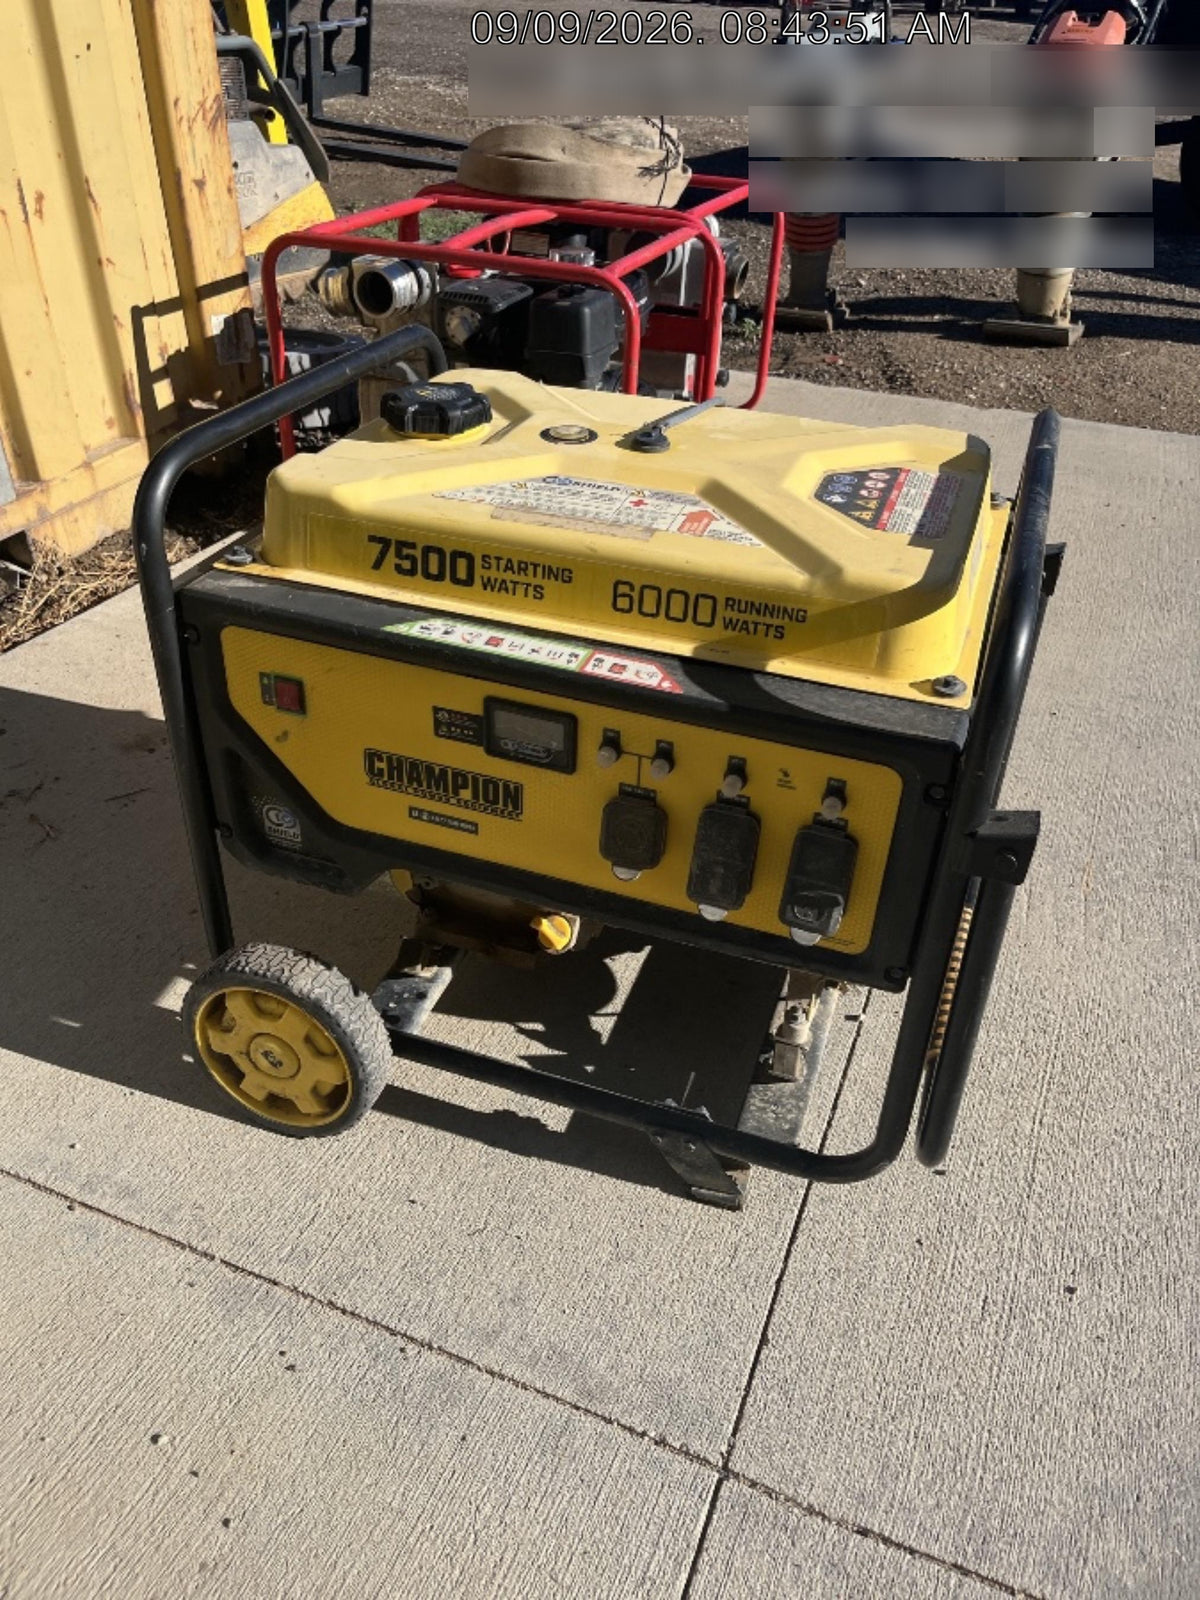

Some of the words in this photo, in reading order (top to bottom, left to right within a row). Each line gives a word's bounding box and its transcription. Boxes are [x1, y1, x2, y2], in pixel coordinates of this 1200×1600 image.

[367, 534, 476, 588] 7500
[480, 553, 574, 585] STARTING
[479, 574, 545, 601] WATTS
[611, 578, 718, 628] 6000
[723, 596, 809, 624] RUNNING
[722, 615, 786, 641] WATTS
[364, 747, 524, 816] CHAMPION
